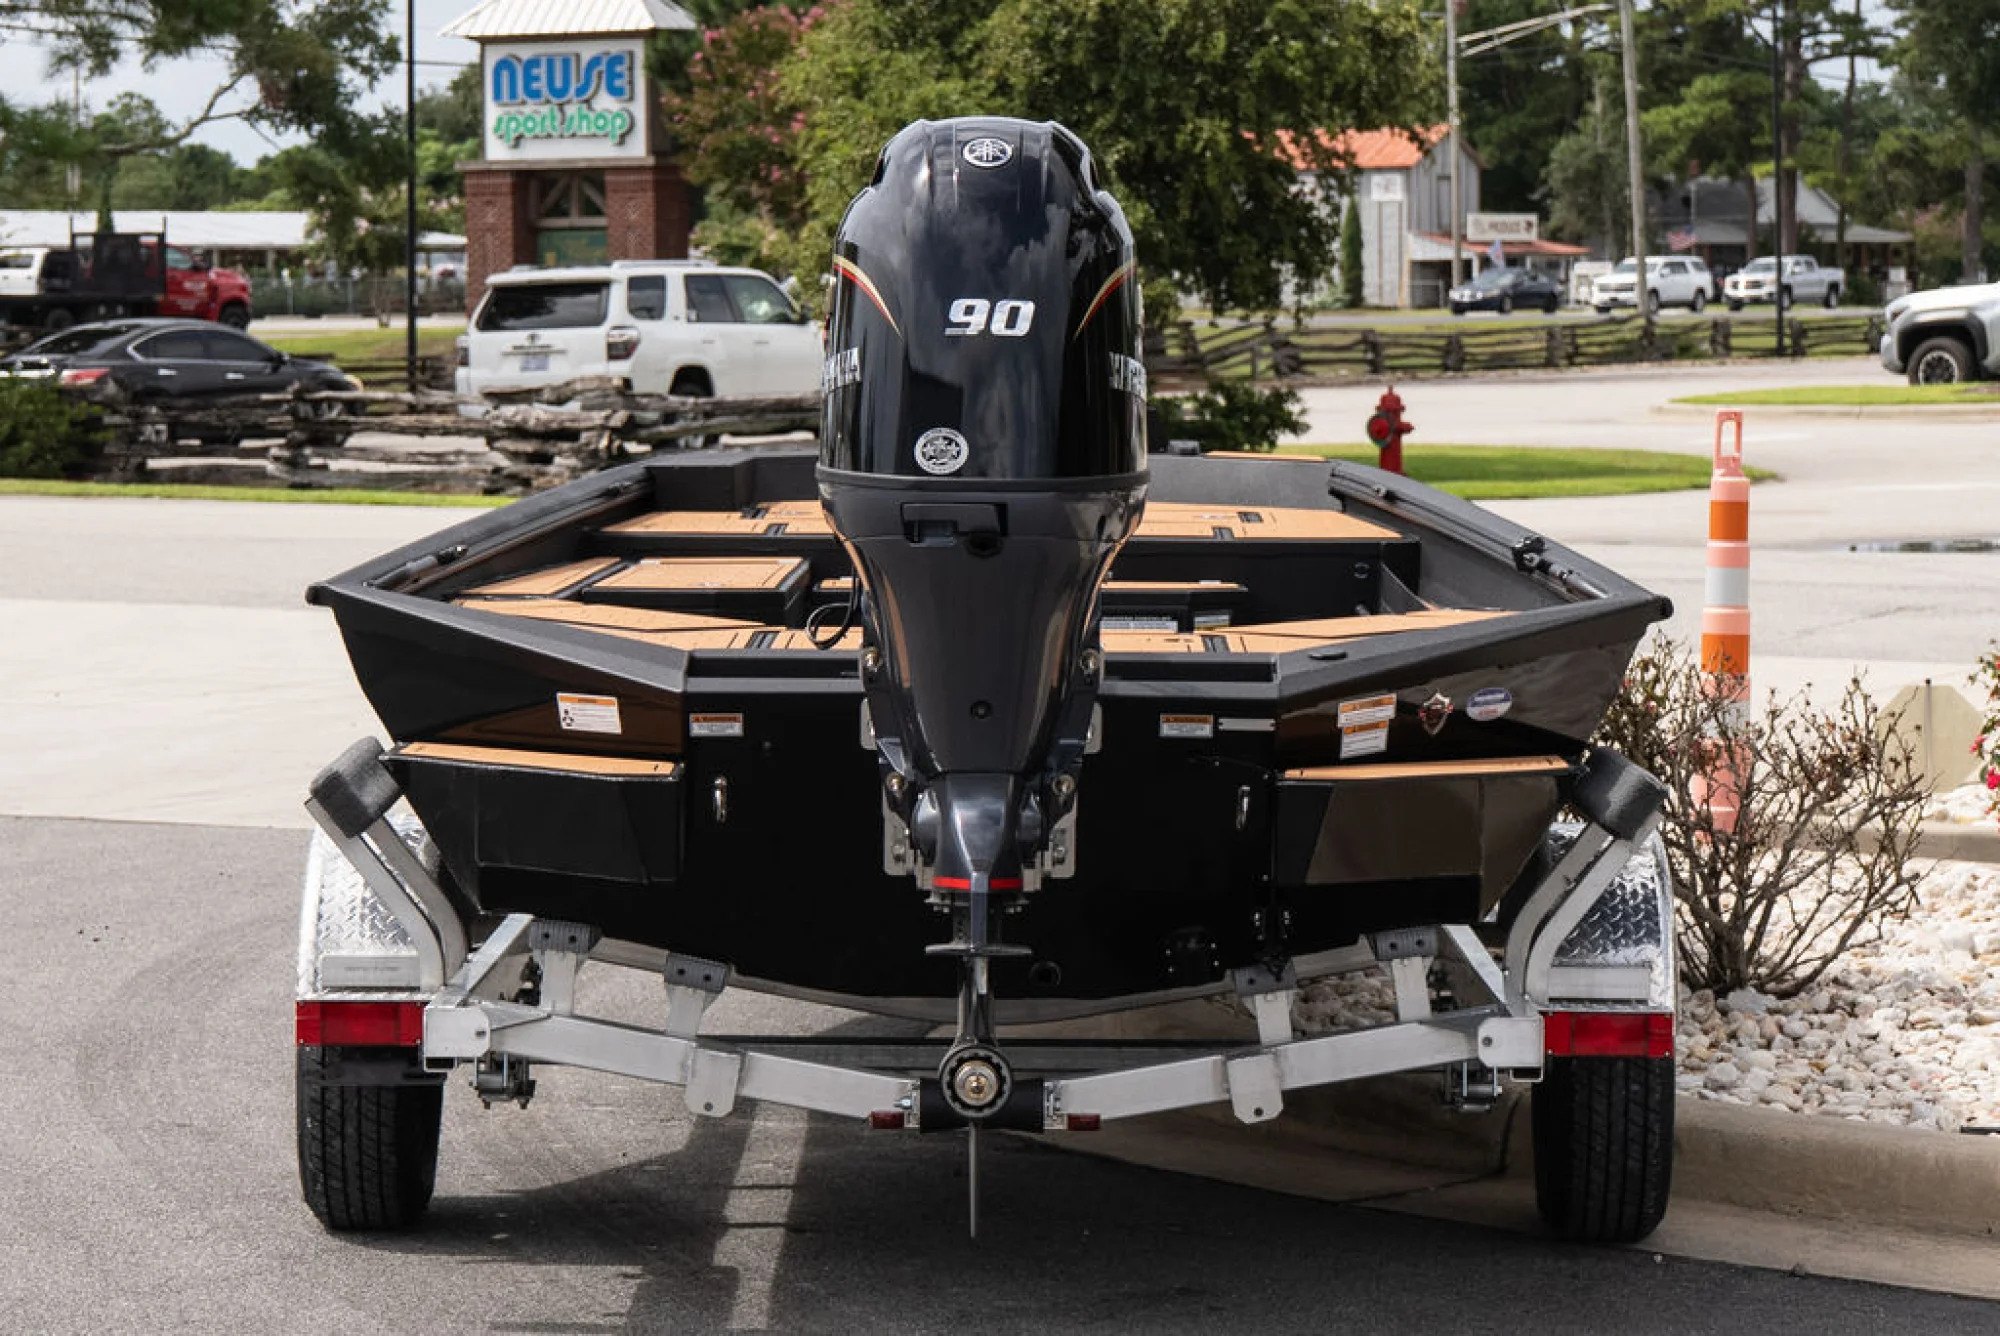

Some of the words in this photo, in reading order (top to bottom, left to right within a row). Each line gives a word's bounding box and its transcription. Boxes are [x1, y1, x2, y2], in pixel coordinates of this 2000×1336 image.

[493, 53, 628, 101] NEUSE
[493, 104, 558, 144] sport
[565, 104, 628, 145] shop
[944, 298, 1036, 337] 90
